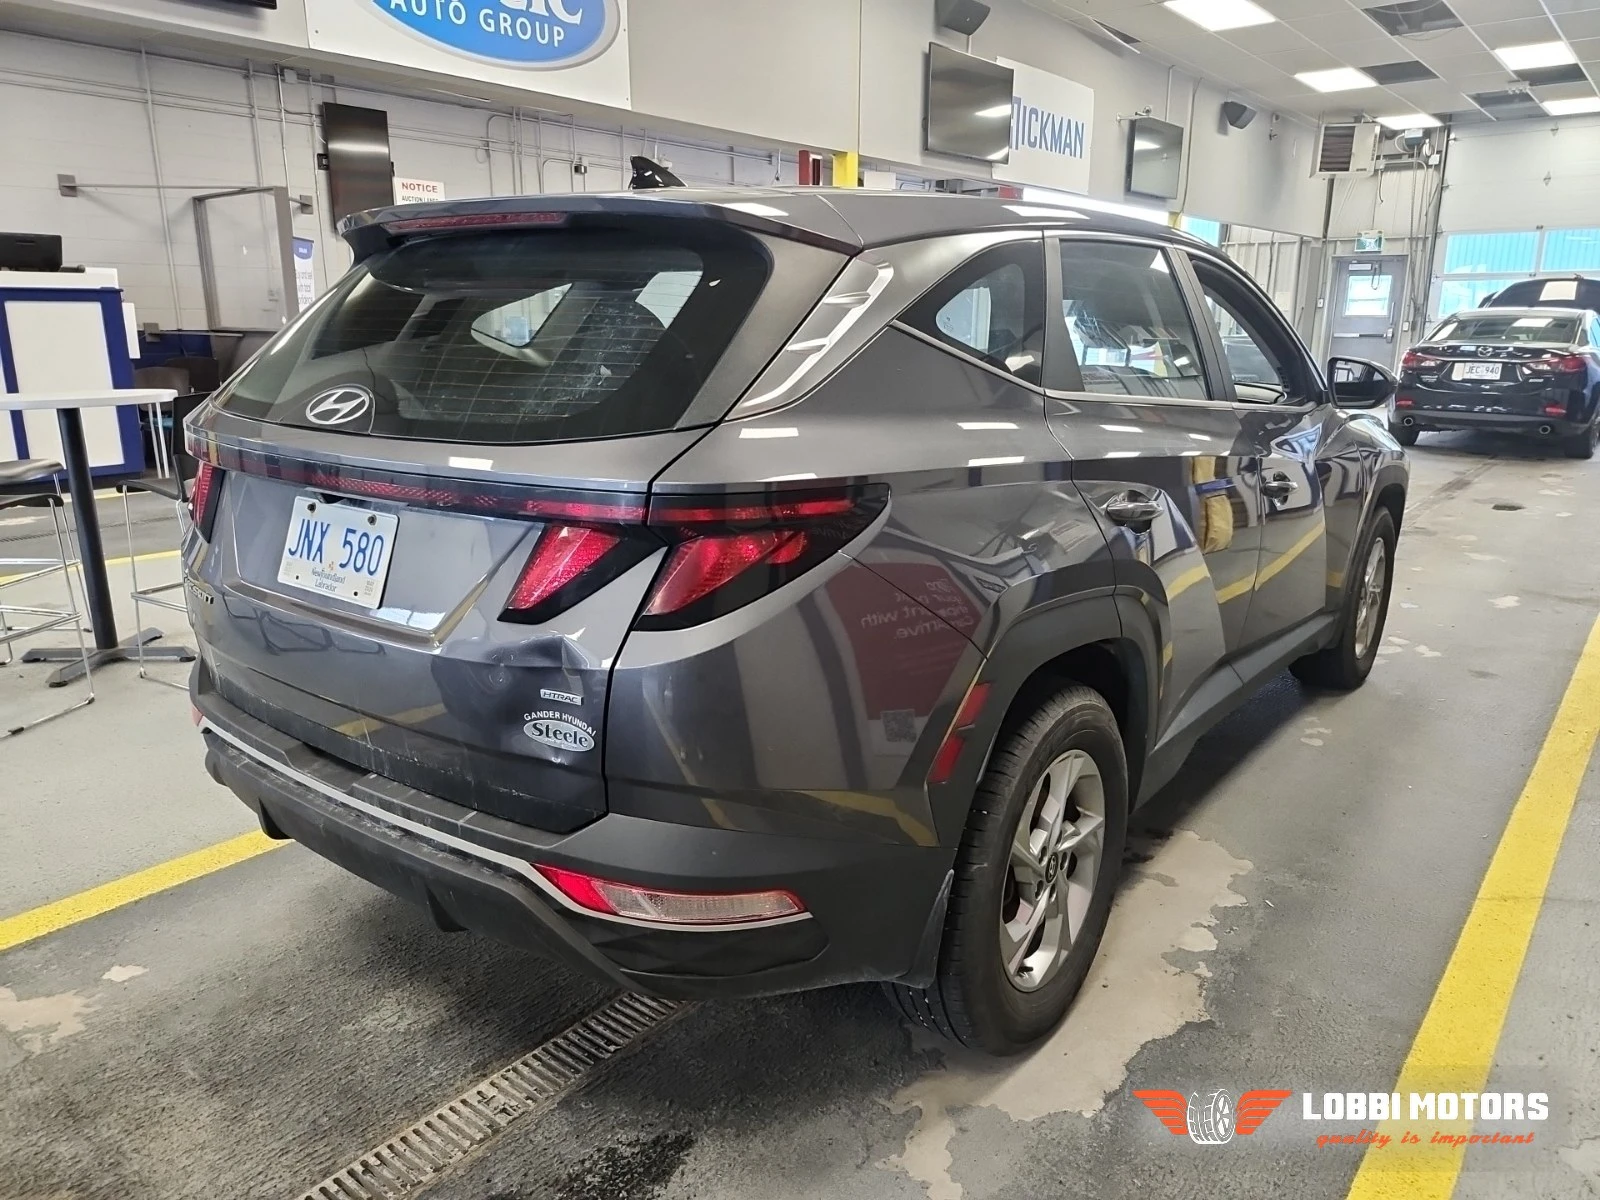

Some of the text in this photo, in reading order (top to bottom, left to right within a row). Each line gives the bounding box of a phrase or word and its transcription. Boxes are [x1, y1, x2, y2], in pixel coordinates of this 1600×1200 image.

[390, 0, 467, 25] AUTO
[479, 9, 565, 47] GROUP
[401, 182, 438, 194] NOTICE
[1485, 365, 1500, 375] 940
[288, 519, 384, 577] JNX 580
[315, 579, 338, 593] Labrador
[543, 691, 579, 704] HTRAC
[523, 710, 597, 737] GANDER HYUNDAI
[531, 722, 588, 748] Steele
